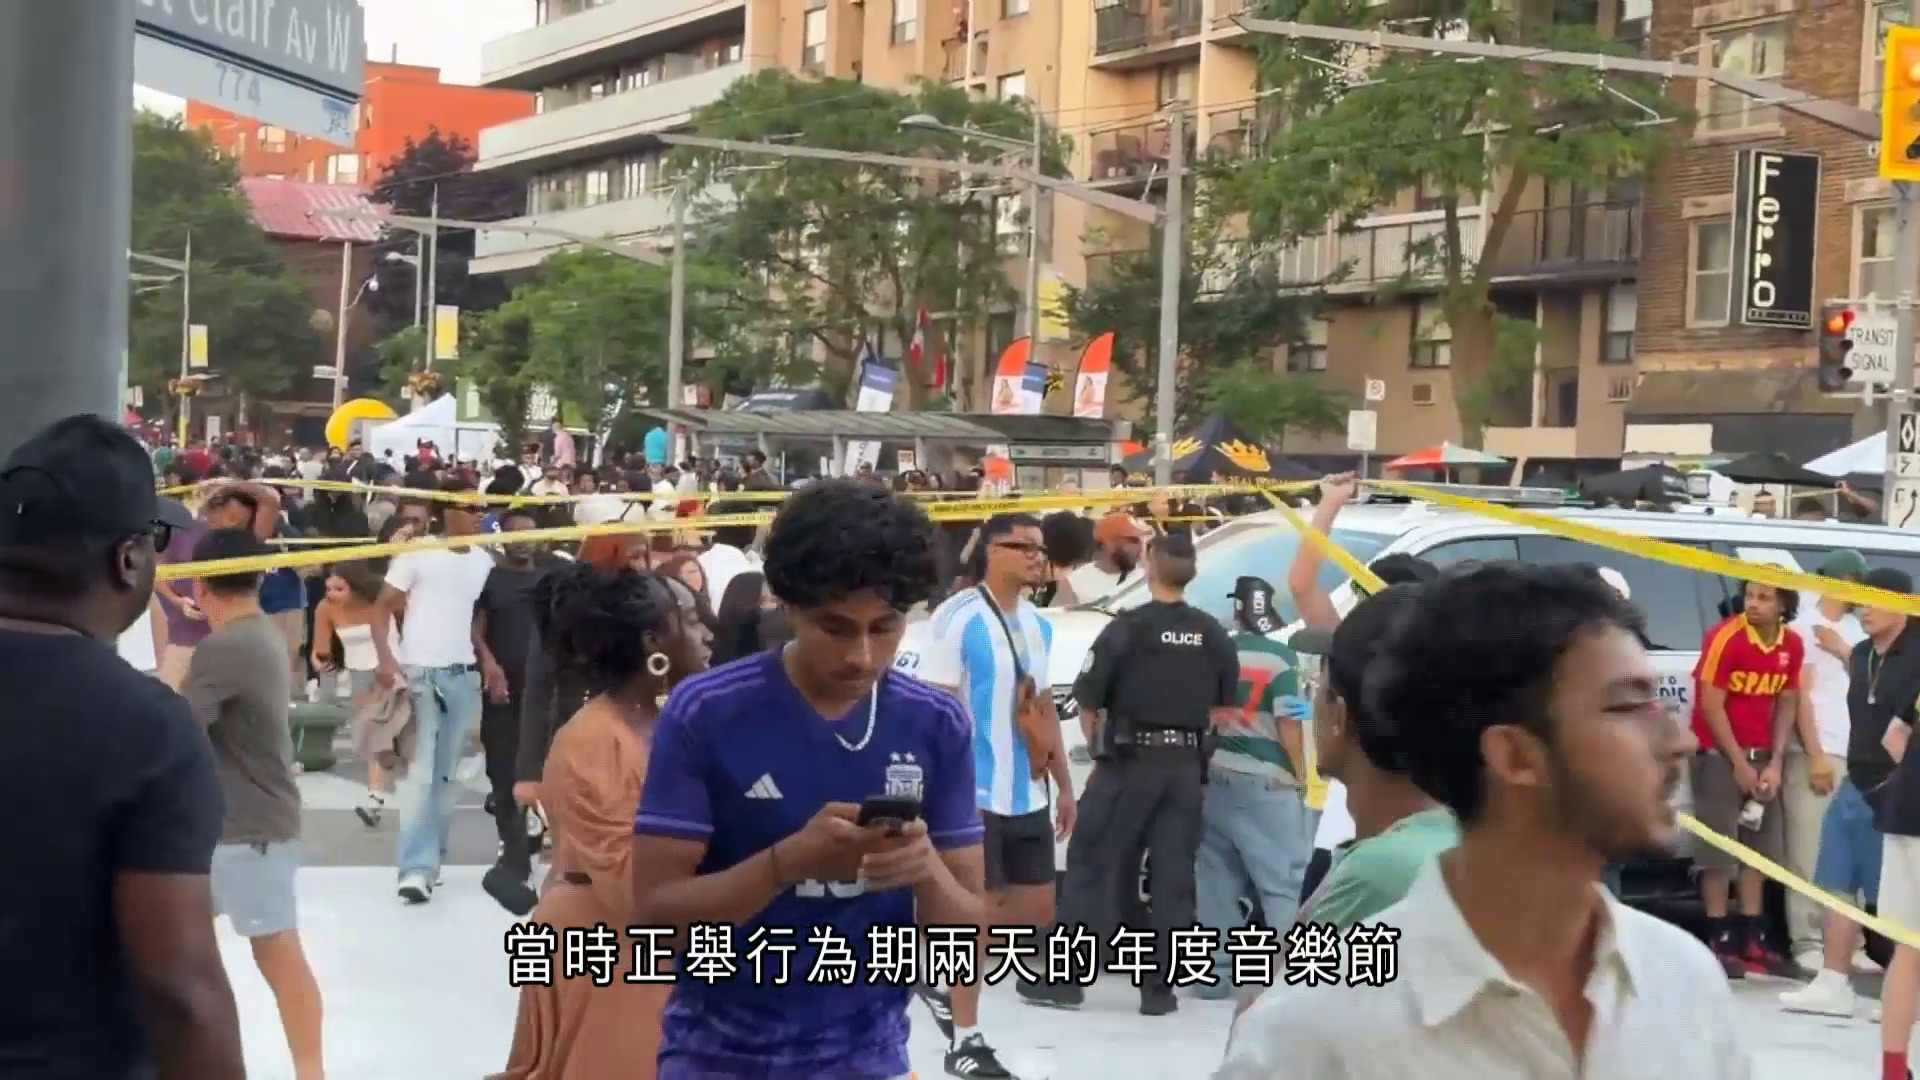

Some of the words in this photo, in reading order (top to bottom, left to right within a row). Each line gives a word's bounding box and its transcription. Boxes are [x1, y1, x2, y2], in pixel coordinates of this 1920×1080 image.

[286, 6, 317, 64] Av
[326, 3, 351, 73] W
[1753, 155, 1783, 308] Ferro
[1851, 327, 1896, 347] TRANSIT
[1852, 352, 1889, 372] SIGNAL
